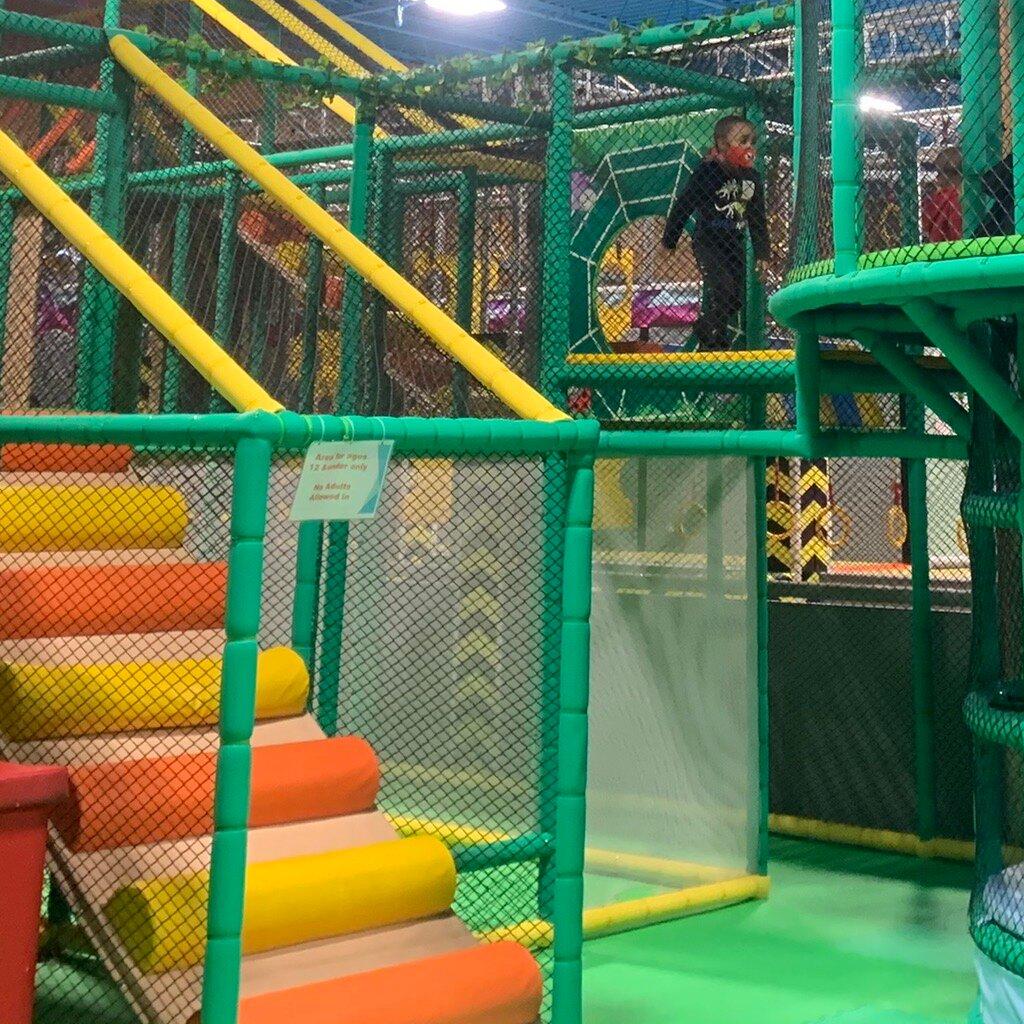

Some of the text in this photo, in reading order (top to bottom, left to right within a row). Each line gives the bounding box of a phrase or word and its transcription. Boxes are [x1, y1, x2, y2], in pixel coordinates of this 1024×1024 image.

[350, 463, 368, 472] only
[313, 482, 351, 491] No Adults
